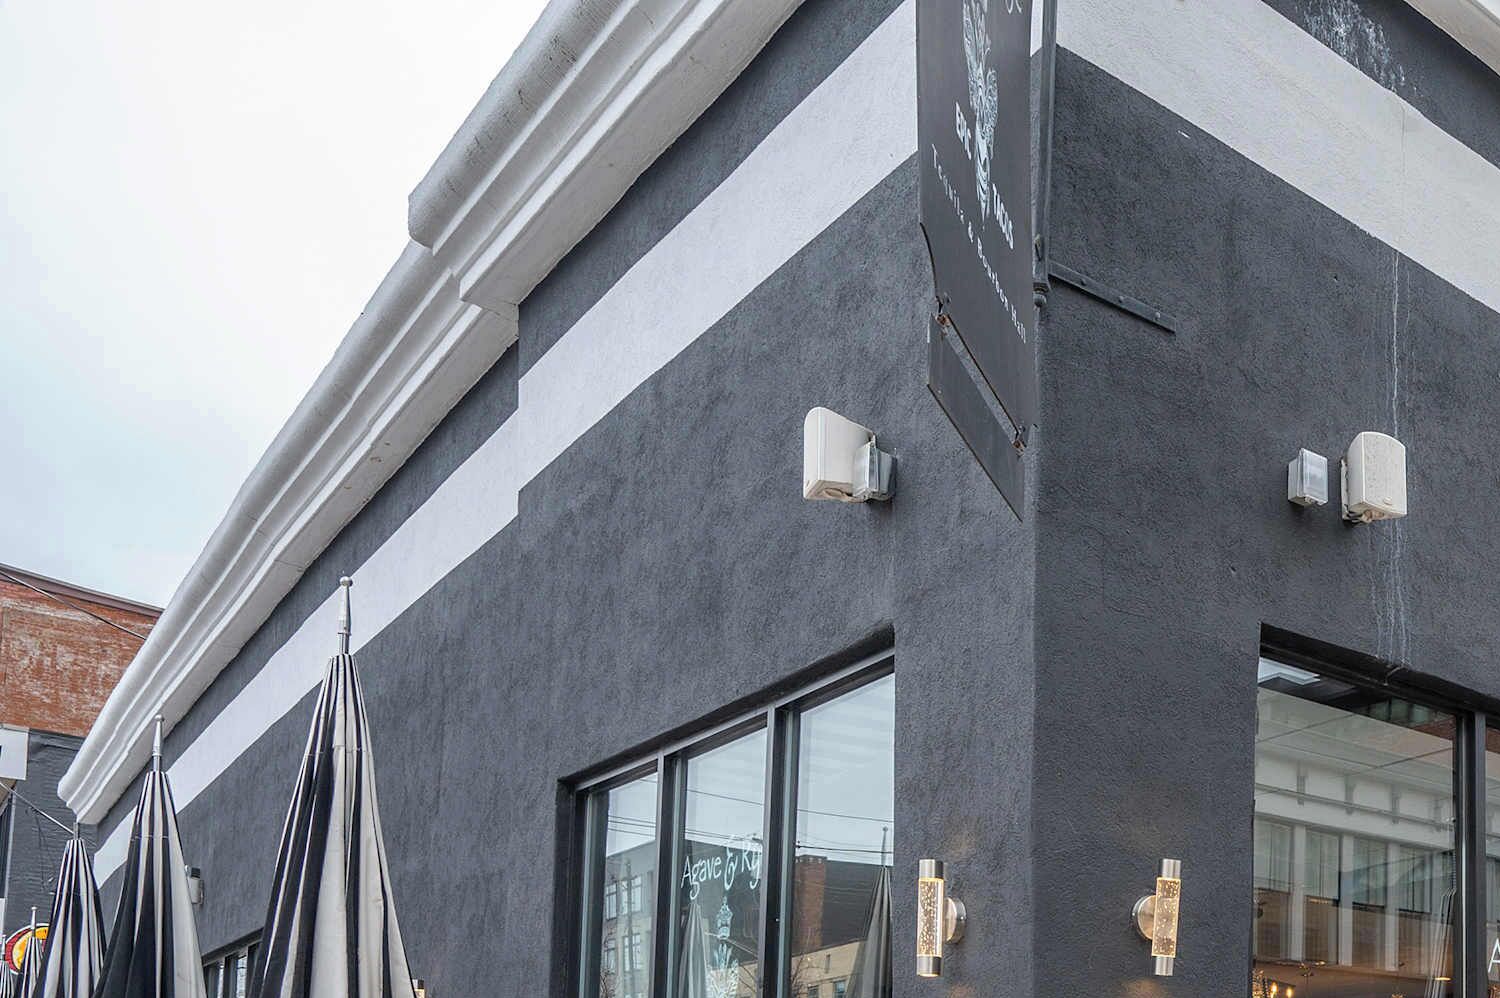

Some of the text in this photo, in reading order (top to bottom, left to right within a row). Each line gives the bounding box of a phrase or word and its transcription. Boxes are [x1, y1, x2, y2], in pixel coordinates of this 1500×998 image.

[955, 101, 972, 160] EPIC
[992, 183, 1014, 250] TACOS
[681, 854, 722, 901] Agave
[741, 838, 763, 890] Ry
